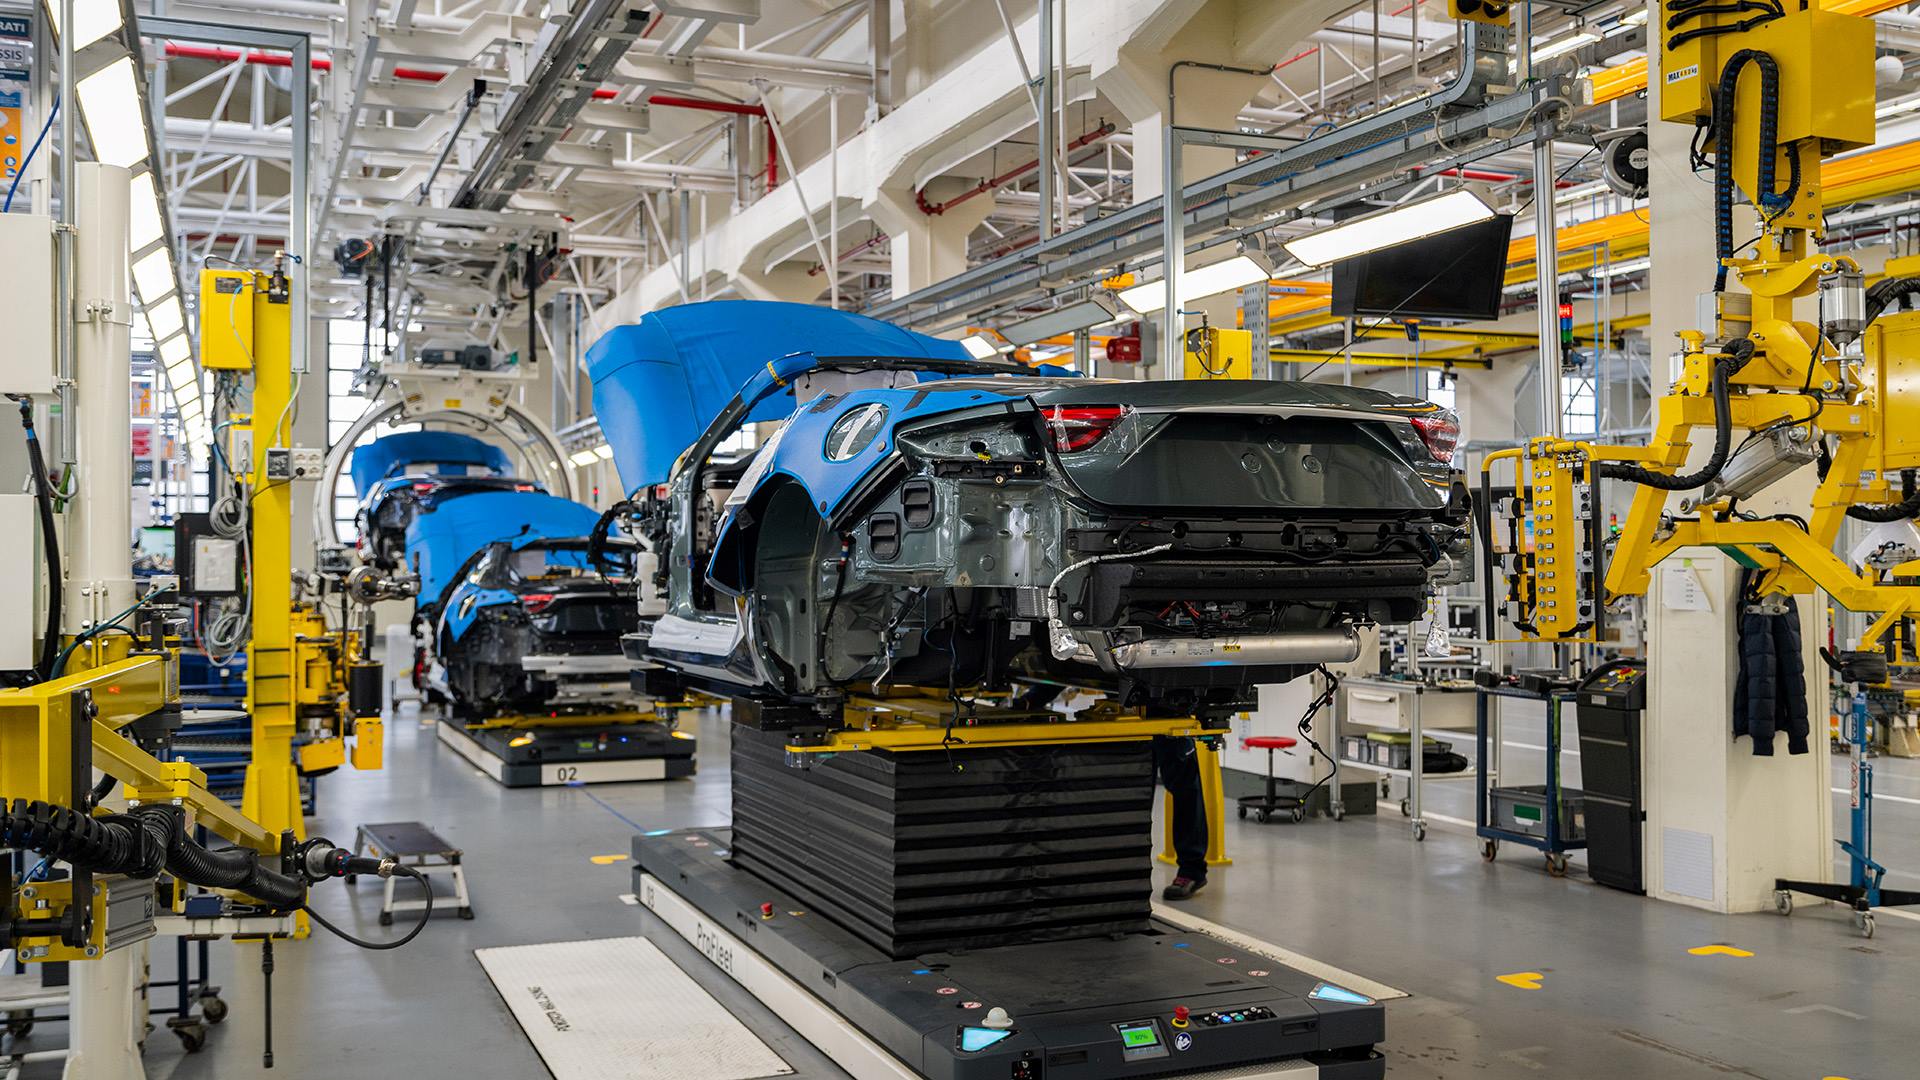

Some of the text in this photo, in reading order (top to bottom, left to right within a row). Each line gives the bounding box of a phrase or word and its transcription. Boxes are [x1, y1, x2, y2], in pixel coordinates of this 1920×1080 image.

[1668, 70, 1680, 82] MAX
[557, 766, 578, 782] 02
[696, 922, 734, 974] ProFleet
